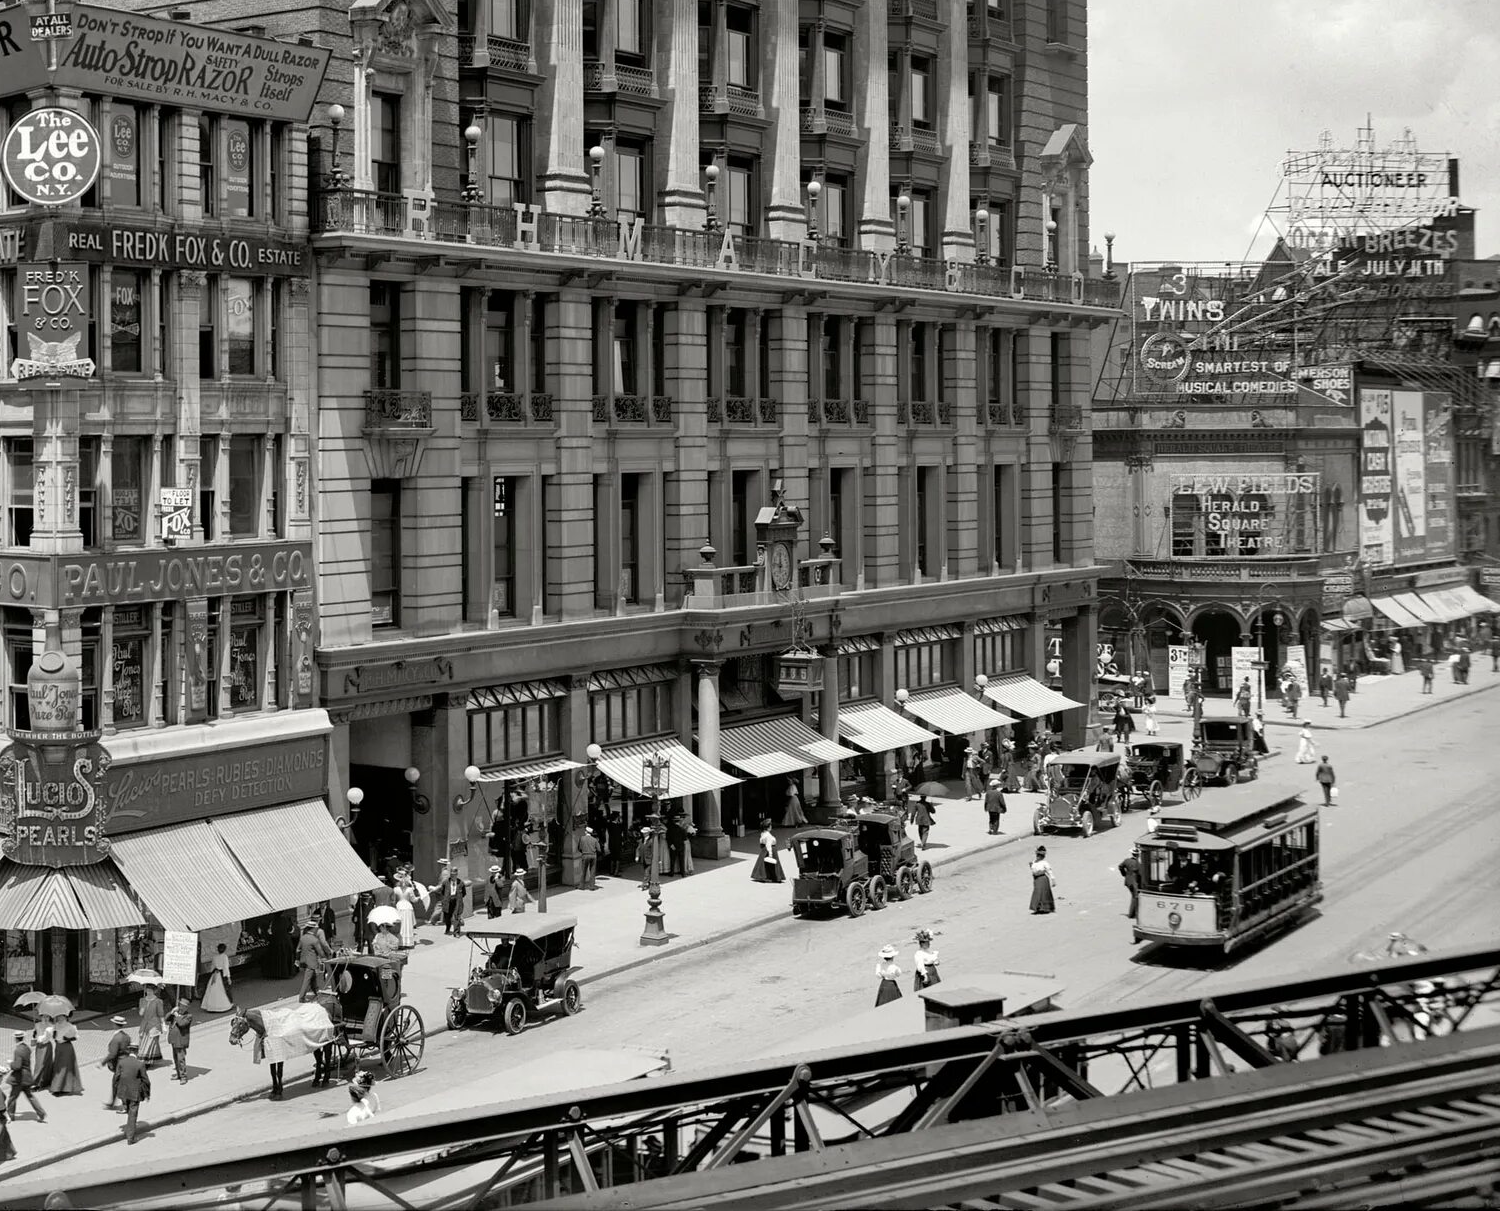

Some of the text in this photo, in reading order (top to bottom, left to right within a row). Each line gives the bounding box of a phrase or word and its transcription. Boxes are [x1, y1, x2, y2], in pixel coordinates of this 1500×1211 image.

[35, 14, 70, 26] AT ALL
[31, 24, 74, 37] DEALERS
[76, 13, 321, 70] DON'T STROP YOU WANT A DULL RAZOR
[61, 33, 255, 96] AutoStrop RAZOR
[204, 54, 240, 69] SAFETY
[263, 64, 305, 87] Strops
[104, 75, 274, 112] FOR SALE BY R. H. MACY & CO.
[259, 82, 294, 103] Itself
[36, 111, 71, 128] The
[113, 125, 132, 139] Lee
[16, 125, 90, 161] Lee
[229, 140, 246, 153] Lee
[24, 160, 84, 182] CO.
[1320, 173, 1428, 188] AUCTIONEER
[35, 184, 72, 196] N.Y.
[69, 232, 104, 251] REAL
[1364, 225, 1460, 254] BREEZES
[112, 229, 253, 269] FRED'K FOX & CO.
[258, 248, 301, 265] ESTATE
[616, 215, 892, 287] MACY
[946, 256, 961, 293] &
[26, 270, 81, 284] FRED'K
[1361, 260, 1405, 276] JULY
[1172, 274, 1187, 295] 3
[22, 284, 86, 316] FOX
[116, 287, 133, 306] FOX
[1140, 296, 1225, 321] TWINS
[34, 317, 74, 330] & CO.
[1162, 343, 1174, 357] A
[1146, 356, 1186, 370] SCREAM
[1195, 361, 1292, 373] SMARTEST OF
[1175, 381, 1298, 394] MUSICAL COMEDIES
[1313, 379, 1351, 390] SHOES
[172, 490, 190, 498] FLOOR
[1178, 476, 1314, 494] LEW FIELDS
[162, 497, 190, 505] TO LET
[1202, 496, 1260, 513] HERALD
[161, 507, 192, 540] FOX
[1208, 513, 1269, 530] SQUARE
[1217, 530, 1284, 548] THEATRE
[65, 550, 308, 597] PAUL JONES & CO.
[112, 641, 133, 662] Paul
[1170, 648, 1179, 662] 3
[114, 660, 142, 683] Jones
[121, 699, 142, 721] Rye
[7, 729, 100, 740] REMEMBER THE BOTTLE
[160, 749, 325, 795] PEARLS RUBIES DIAMONDS
[194, 776, 292, 806] DEFY DETECTION
[16, 825, 97, 846] PEARLS
[1156, 900, 1195, 912] 678
